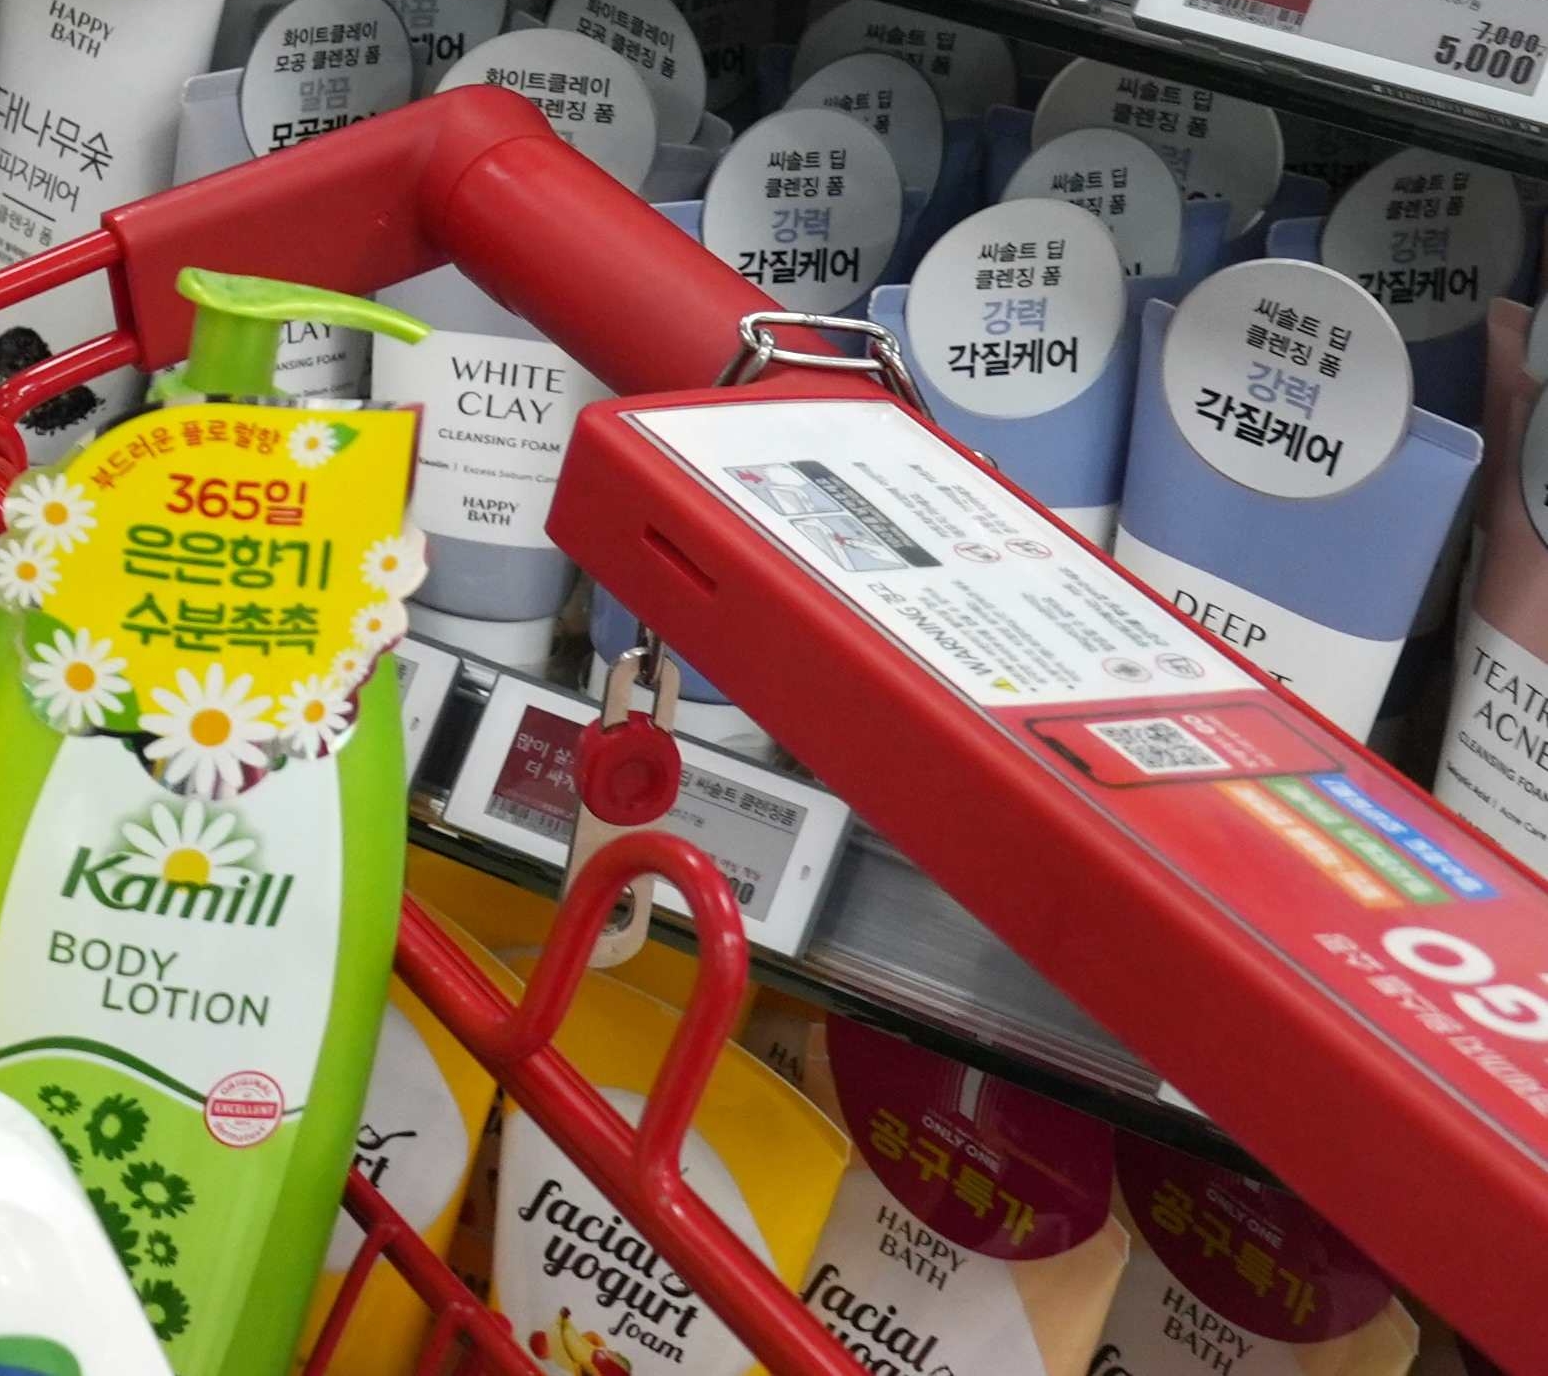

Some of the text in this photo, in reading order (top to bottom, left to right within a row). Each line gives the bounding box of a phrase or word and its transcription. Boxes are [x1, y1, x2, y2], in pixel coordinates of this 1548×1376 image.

[49, 0, 116, 42] HAPPY
[50, 22, 103, 59] BATH
[283, 21, 379, 49] 화이트클레이
[1434, 34, 1536, 85] 5,000
[299, 78, 352, 114] 말끔
[768, 150, 823, 172] 씨솔트
[770, 209, 831, 242] 강력
[977, 241, 1038, 265] 씨솔트
[450, 355, 566, 394] WHITE
[946, 337, 1078, 379] 각질케어
[456, 389, 555, 424] CLAY
[1244, 358, 1321, 418] 강력
[437, 428, 516, 449] CLEANSING
[1193, 385, 1345, 478] 각질케어
[165, 474, 308, 527] 365일
[467, 510, 513, 528] BATH
[122, 524, 333, 590] 은은향기
[121, 593, 322, 655] 수분촉촉
[60, 845, 295, 928] Kamill
[47, 930, 179, 983] BODY
[100, 976, 271, 1028] LOTION
[867, 1105, 1038, 1249] 공구특가
[878, 1205, 967, 1270] HAPPY
[542, 1234, 698, 1339] yogurt
[608, 1309, 684, 1364] foam
[799, 1263, 939, 1373] facial
